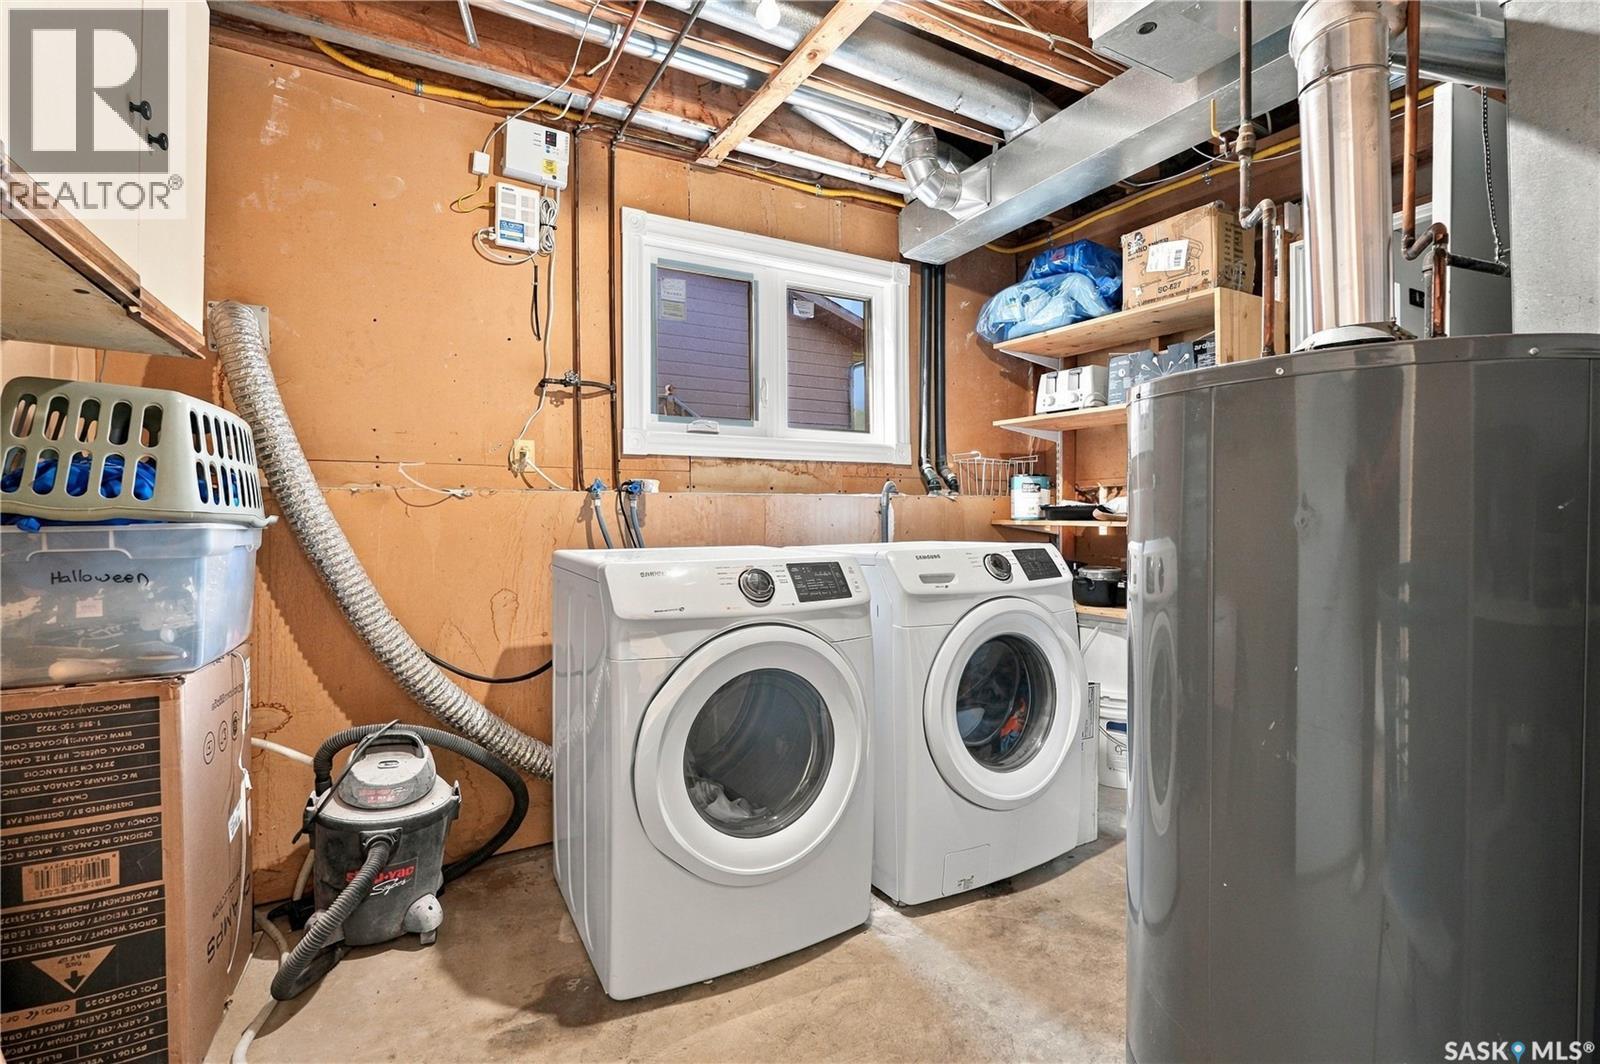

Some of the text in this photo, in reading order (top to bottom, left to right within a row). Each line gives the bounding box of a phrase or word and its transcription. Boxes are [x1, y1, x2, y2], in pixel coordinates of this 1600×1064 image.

[50, 569, 150, 586] Halloween
[44, 780, 81, 790] CANADA
[84, 774, 118, 785] CHAMPS
[52, 793, 88, 803] CHAMPS
[73, 824, 111, 835] CANADA
[113, 831, 153, 843] DESIGNED
[61, 840, 100, 851] CANADA
[27, 847, 52, 856] MADE
[96, 889, 159, 908] MEASUREMENT
[93, 910, 129, 923] WEIGHT
[130, 907, 148, 915] NET
[128, 918, 158, 928] GROSS
[91, 925, 126, 938] WEIGHT
[125, 998, 161, 1013] BAGAGE
[110, 1008, 122, 1016] DE
[73, 1013, 108, 1025] CABINE
